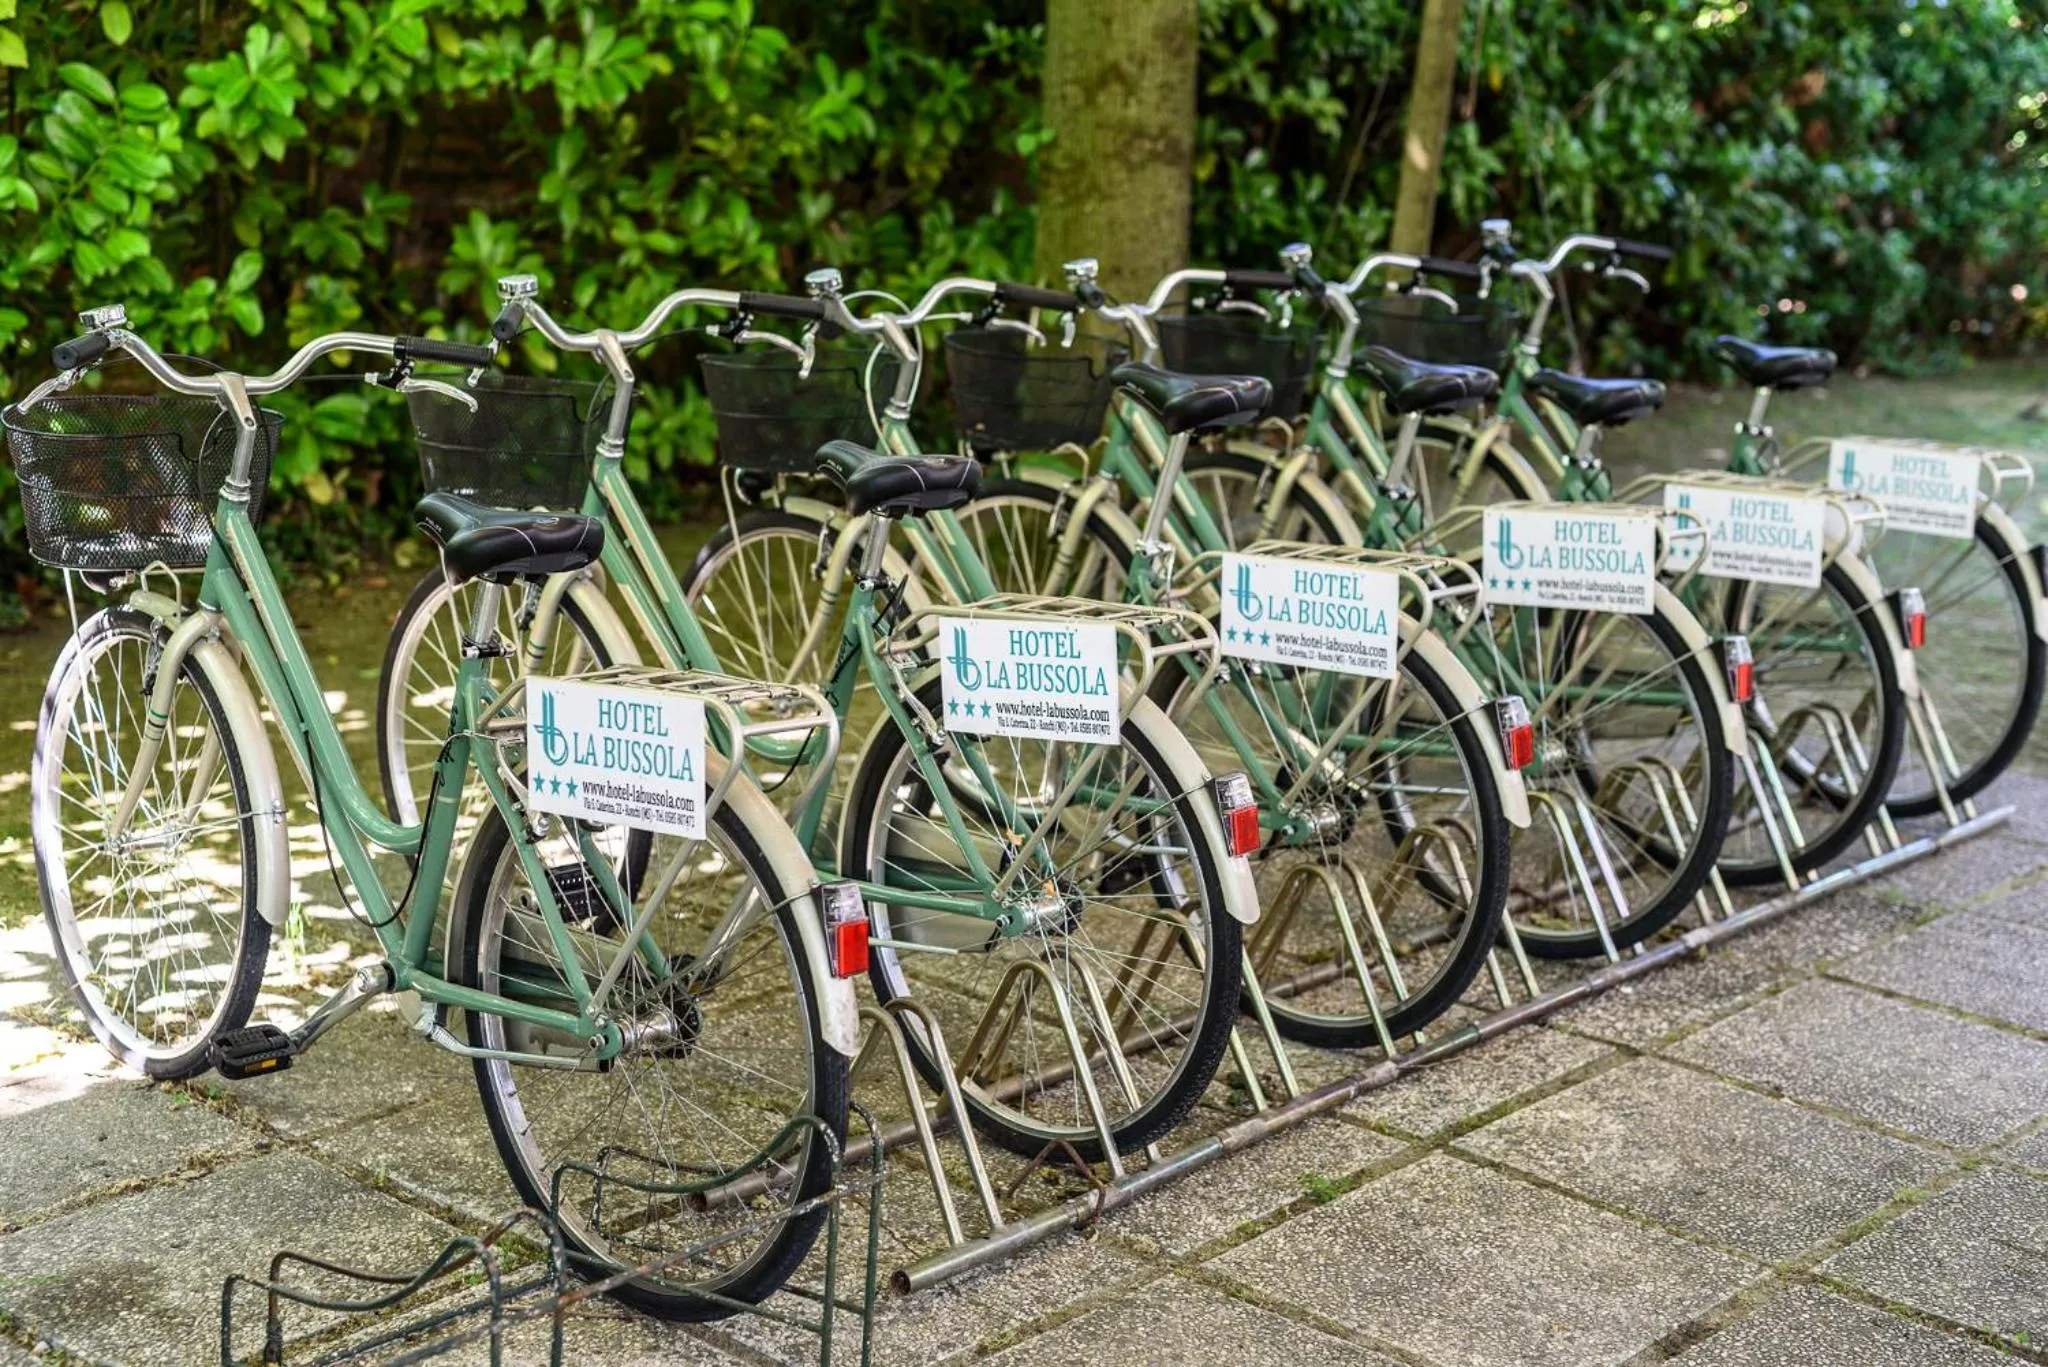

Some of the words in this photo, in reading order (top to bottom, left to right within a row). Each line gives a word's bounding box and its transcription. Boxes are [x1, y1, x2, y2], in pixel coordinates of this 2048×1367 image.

[1893, 454, 1951, 478] HOTEL
[1868, 473, 1888, 494] LA
[1730, 497, 1794, 523] HOTEL
[1554, 520, 1622, 545] HOTEL
[1732, 523, 1814, 550] BUSSOLA
[1529, 545, 1552, 569] LA
[1559, 549, 1645, 575] BUSSOLA
[1294, 569, 1364, 601] HOTEL
[1268, 595, 1292, 622] LA
[1298, 600, 1388, 635] BUSSOLA
[1009, 629, 1081, 659] HOTEL
[1275, 633, 1387, 658] www.hotel-labussola.com
[985, 660, 1011, 689] LA
[1016, 662, 1109, 696] BUSSOLA
[598, 699, 669, 737] HOTEL
[996, 700, 1110, 722] www.hotel-labussola.com
[573, 732, 598, 767] LA
[603, 737, 695, 782] BUSSOLA
[582, 780, 694, 812] www.hotel-labussola.com
